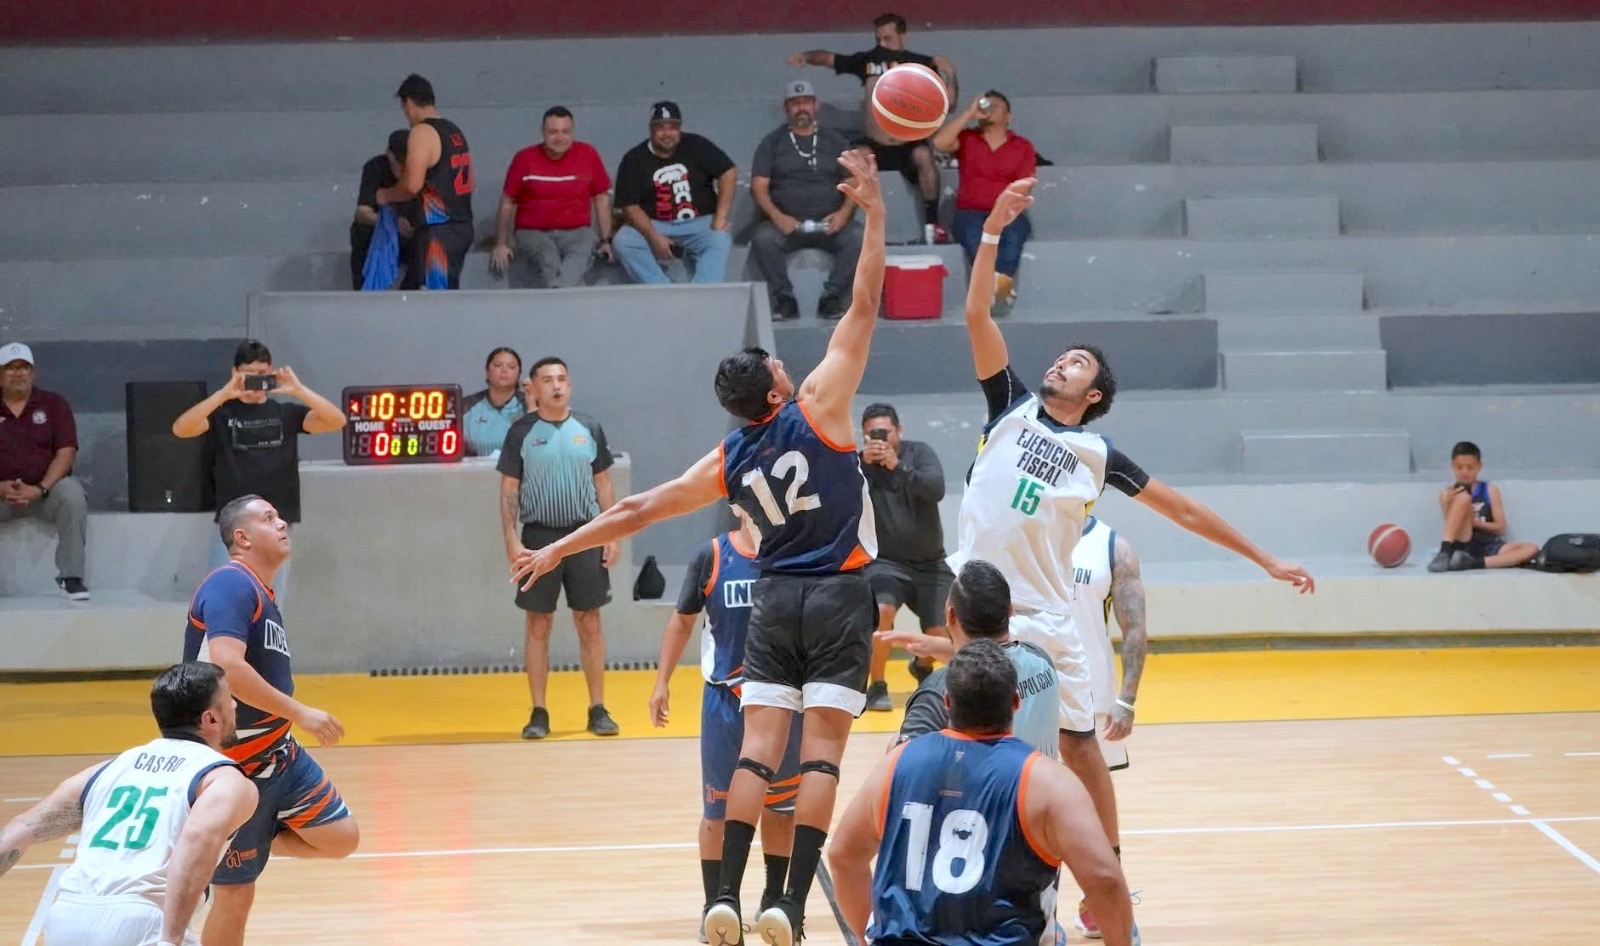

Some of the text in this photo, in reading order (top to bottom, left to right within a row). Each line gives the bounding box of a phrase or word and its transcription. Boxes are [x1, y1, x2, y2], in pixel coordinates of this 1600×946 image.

[370, 391, 444, 420] 10:00
[355, 421, 385, 432] HOME
[375, 432, 389, 456] 0
[442, 431, 456, 454] 0
[418, 420, 452, 431] GUEST
[1016, 428, 1079, 475] EJECUCION
[1017, 450, 1062, 487] FISCAL
[741, 449, 822, 526] 12
[1011, 477, 1045, 516] 15
[134, 752, 186, 773] CASRO
[89, 784, 169, 851] 25
[902, 801, 989, 894] 18
